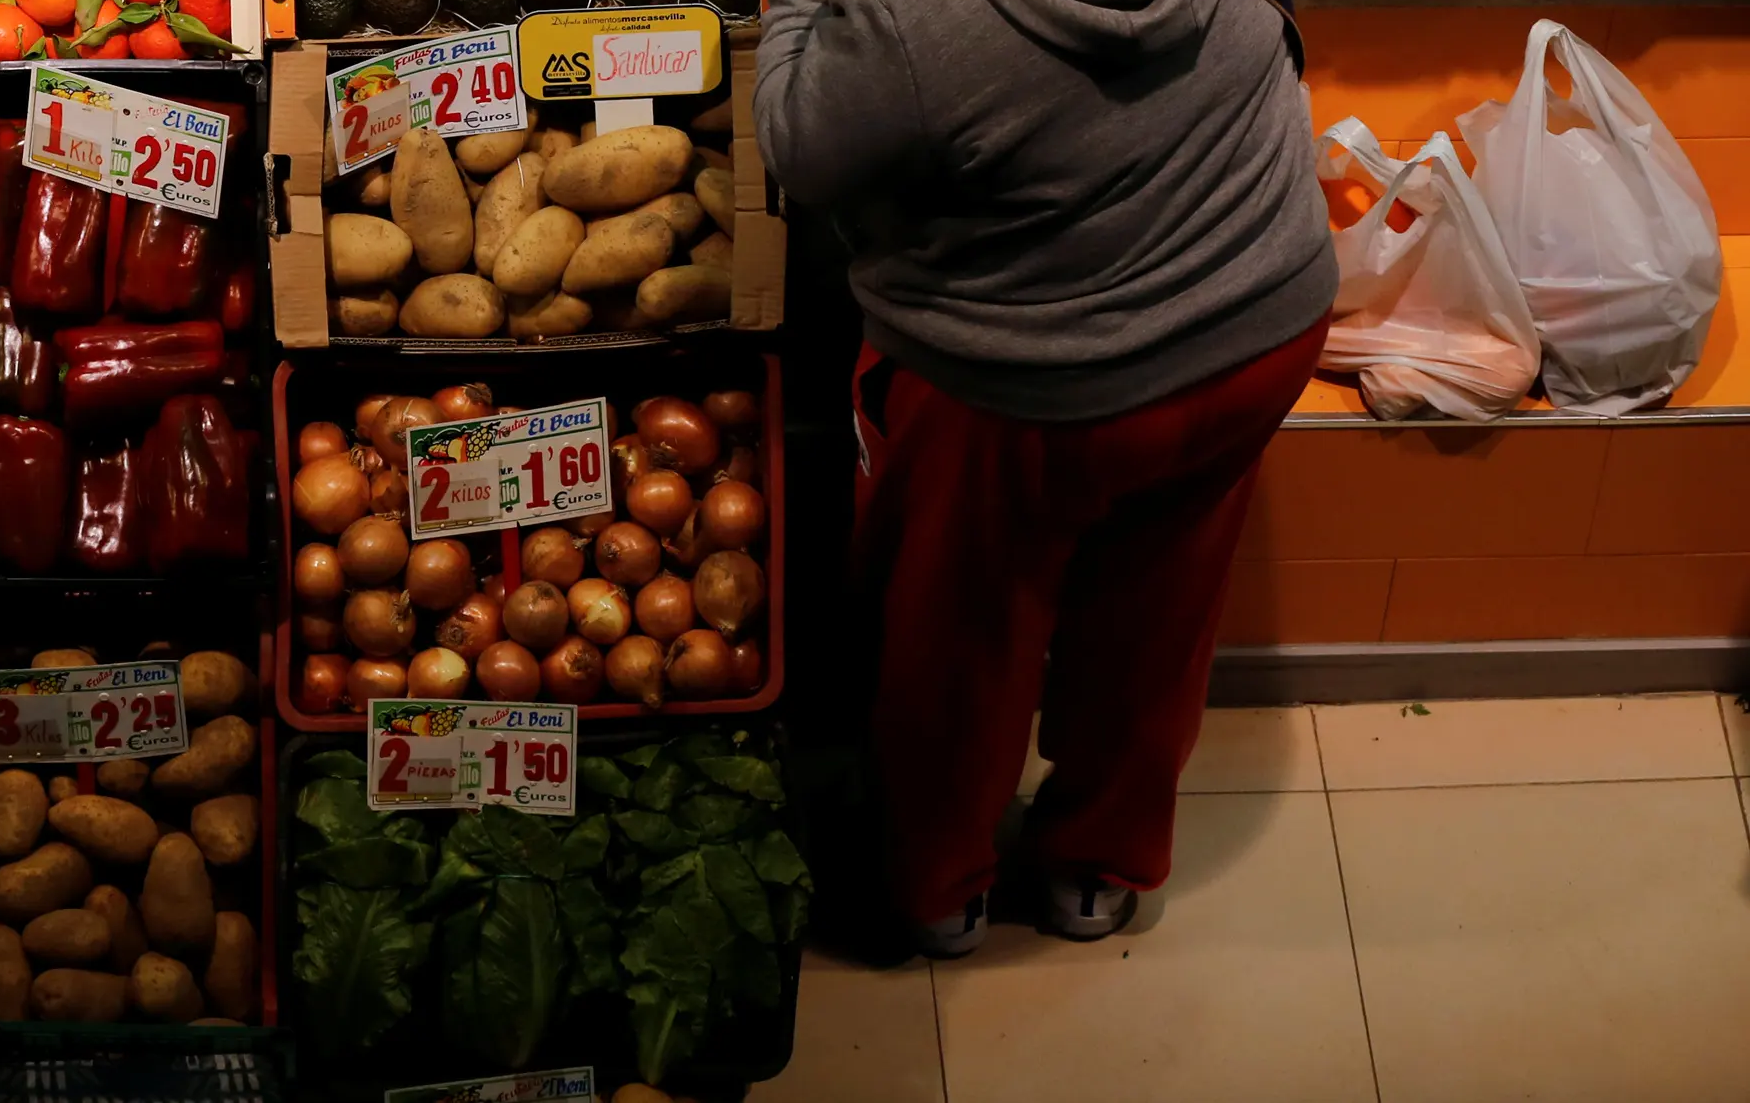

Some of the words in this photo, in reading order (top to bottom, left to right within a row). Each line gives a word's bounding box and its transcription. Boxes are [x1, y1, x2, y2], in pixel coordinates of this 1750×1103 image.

[430, 60, 516, 128] 2'40
[41, 100, 65, 157] 1
[341, 104, 369, 161] 2
[130, 134, 217, 191] 2'50
[418, 467, 450, 523] 2
[521, 443, 601, 510] 1'60
[90, 694, 176, 749] 2'25
[376, 737, 411, 792] 2
[485, 739, 568, 796] 1'50
